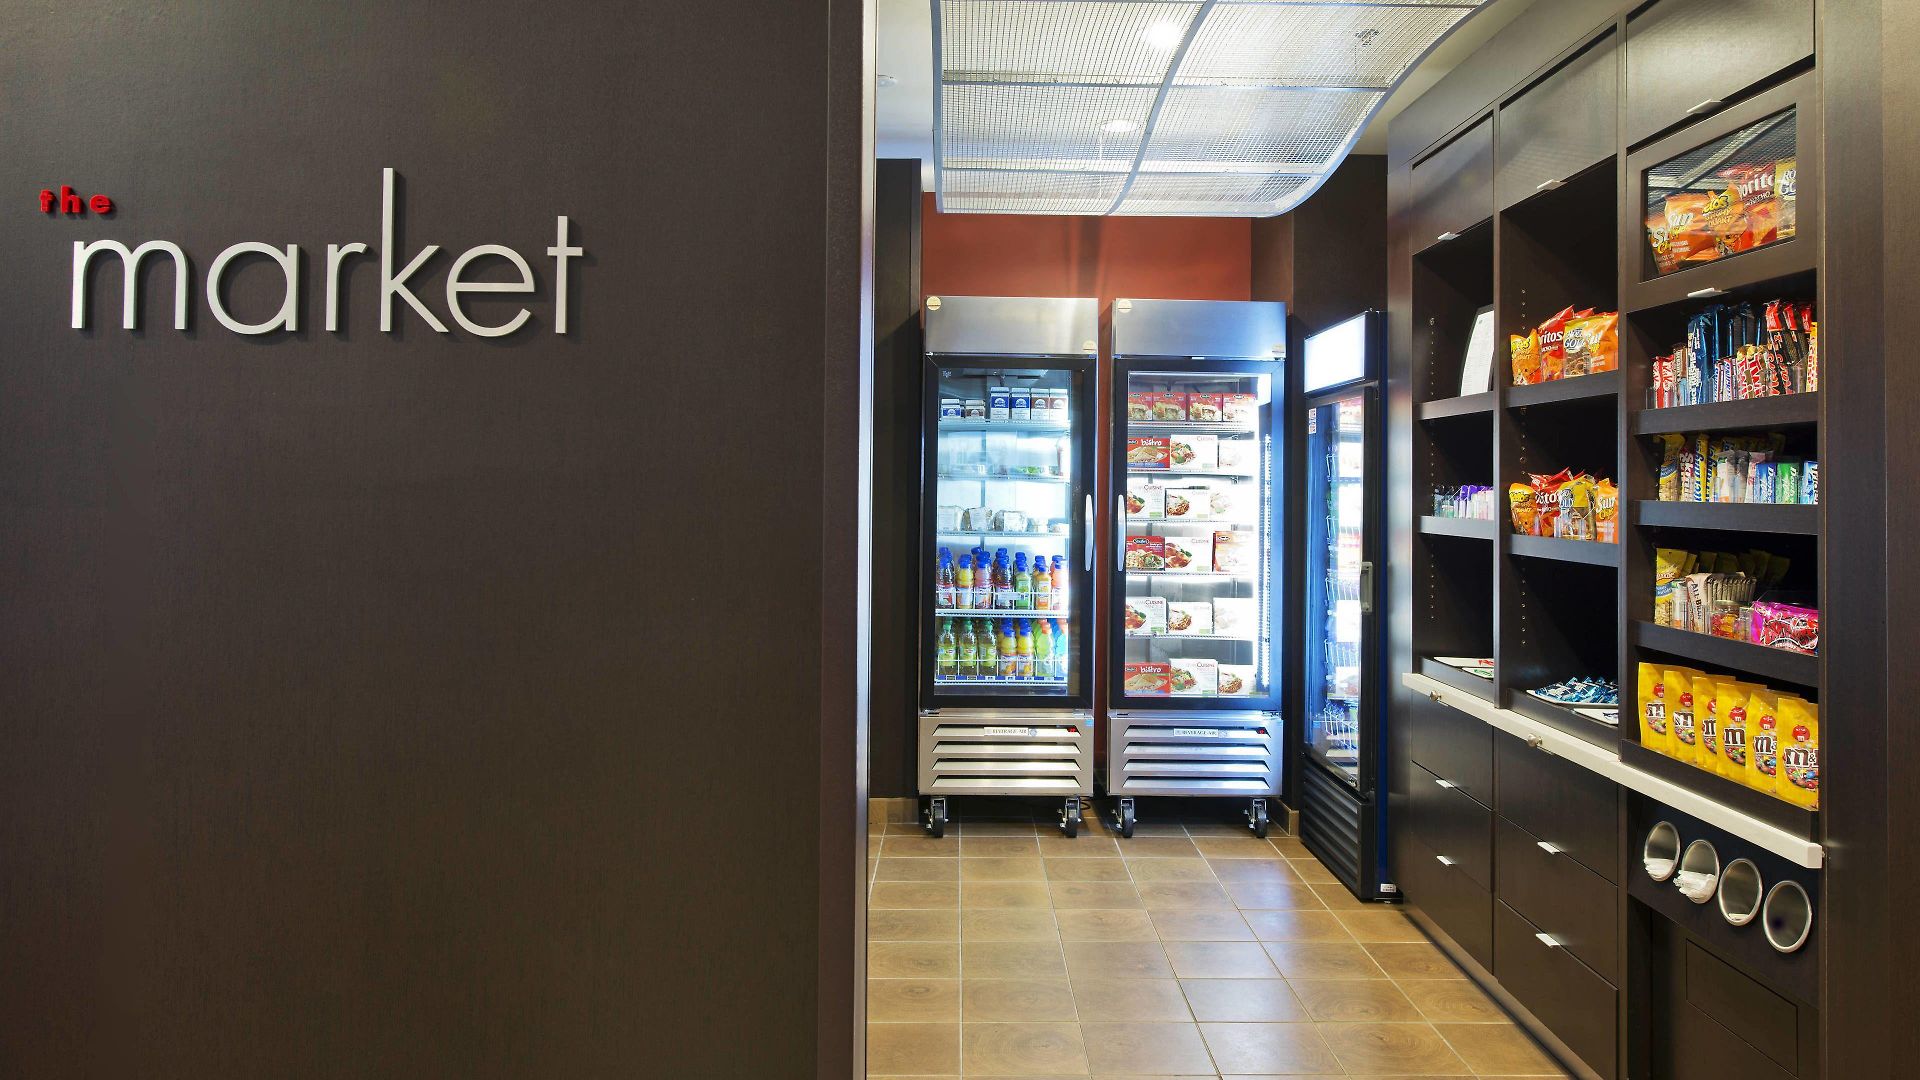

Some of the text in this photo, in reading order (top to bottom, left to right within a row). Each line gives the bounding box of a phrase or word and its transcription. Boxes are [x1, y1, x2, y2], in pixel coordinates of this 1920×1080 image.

[39, 185, 111, 214] the
[72, 168, 583, 337] market
[1596, 497, 1615, 513] Sun
